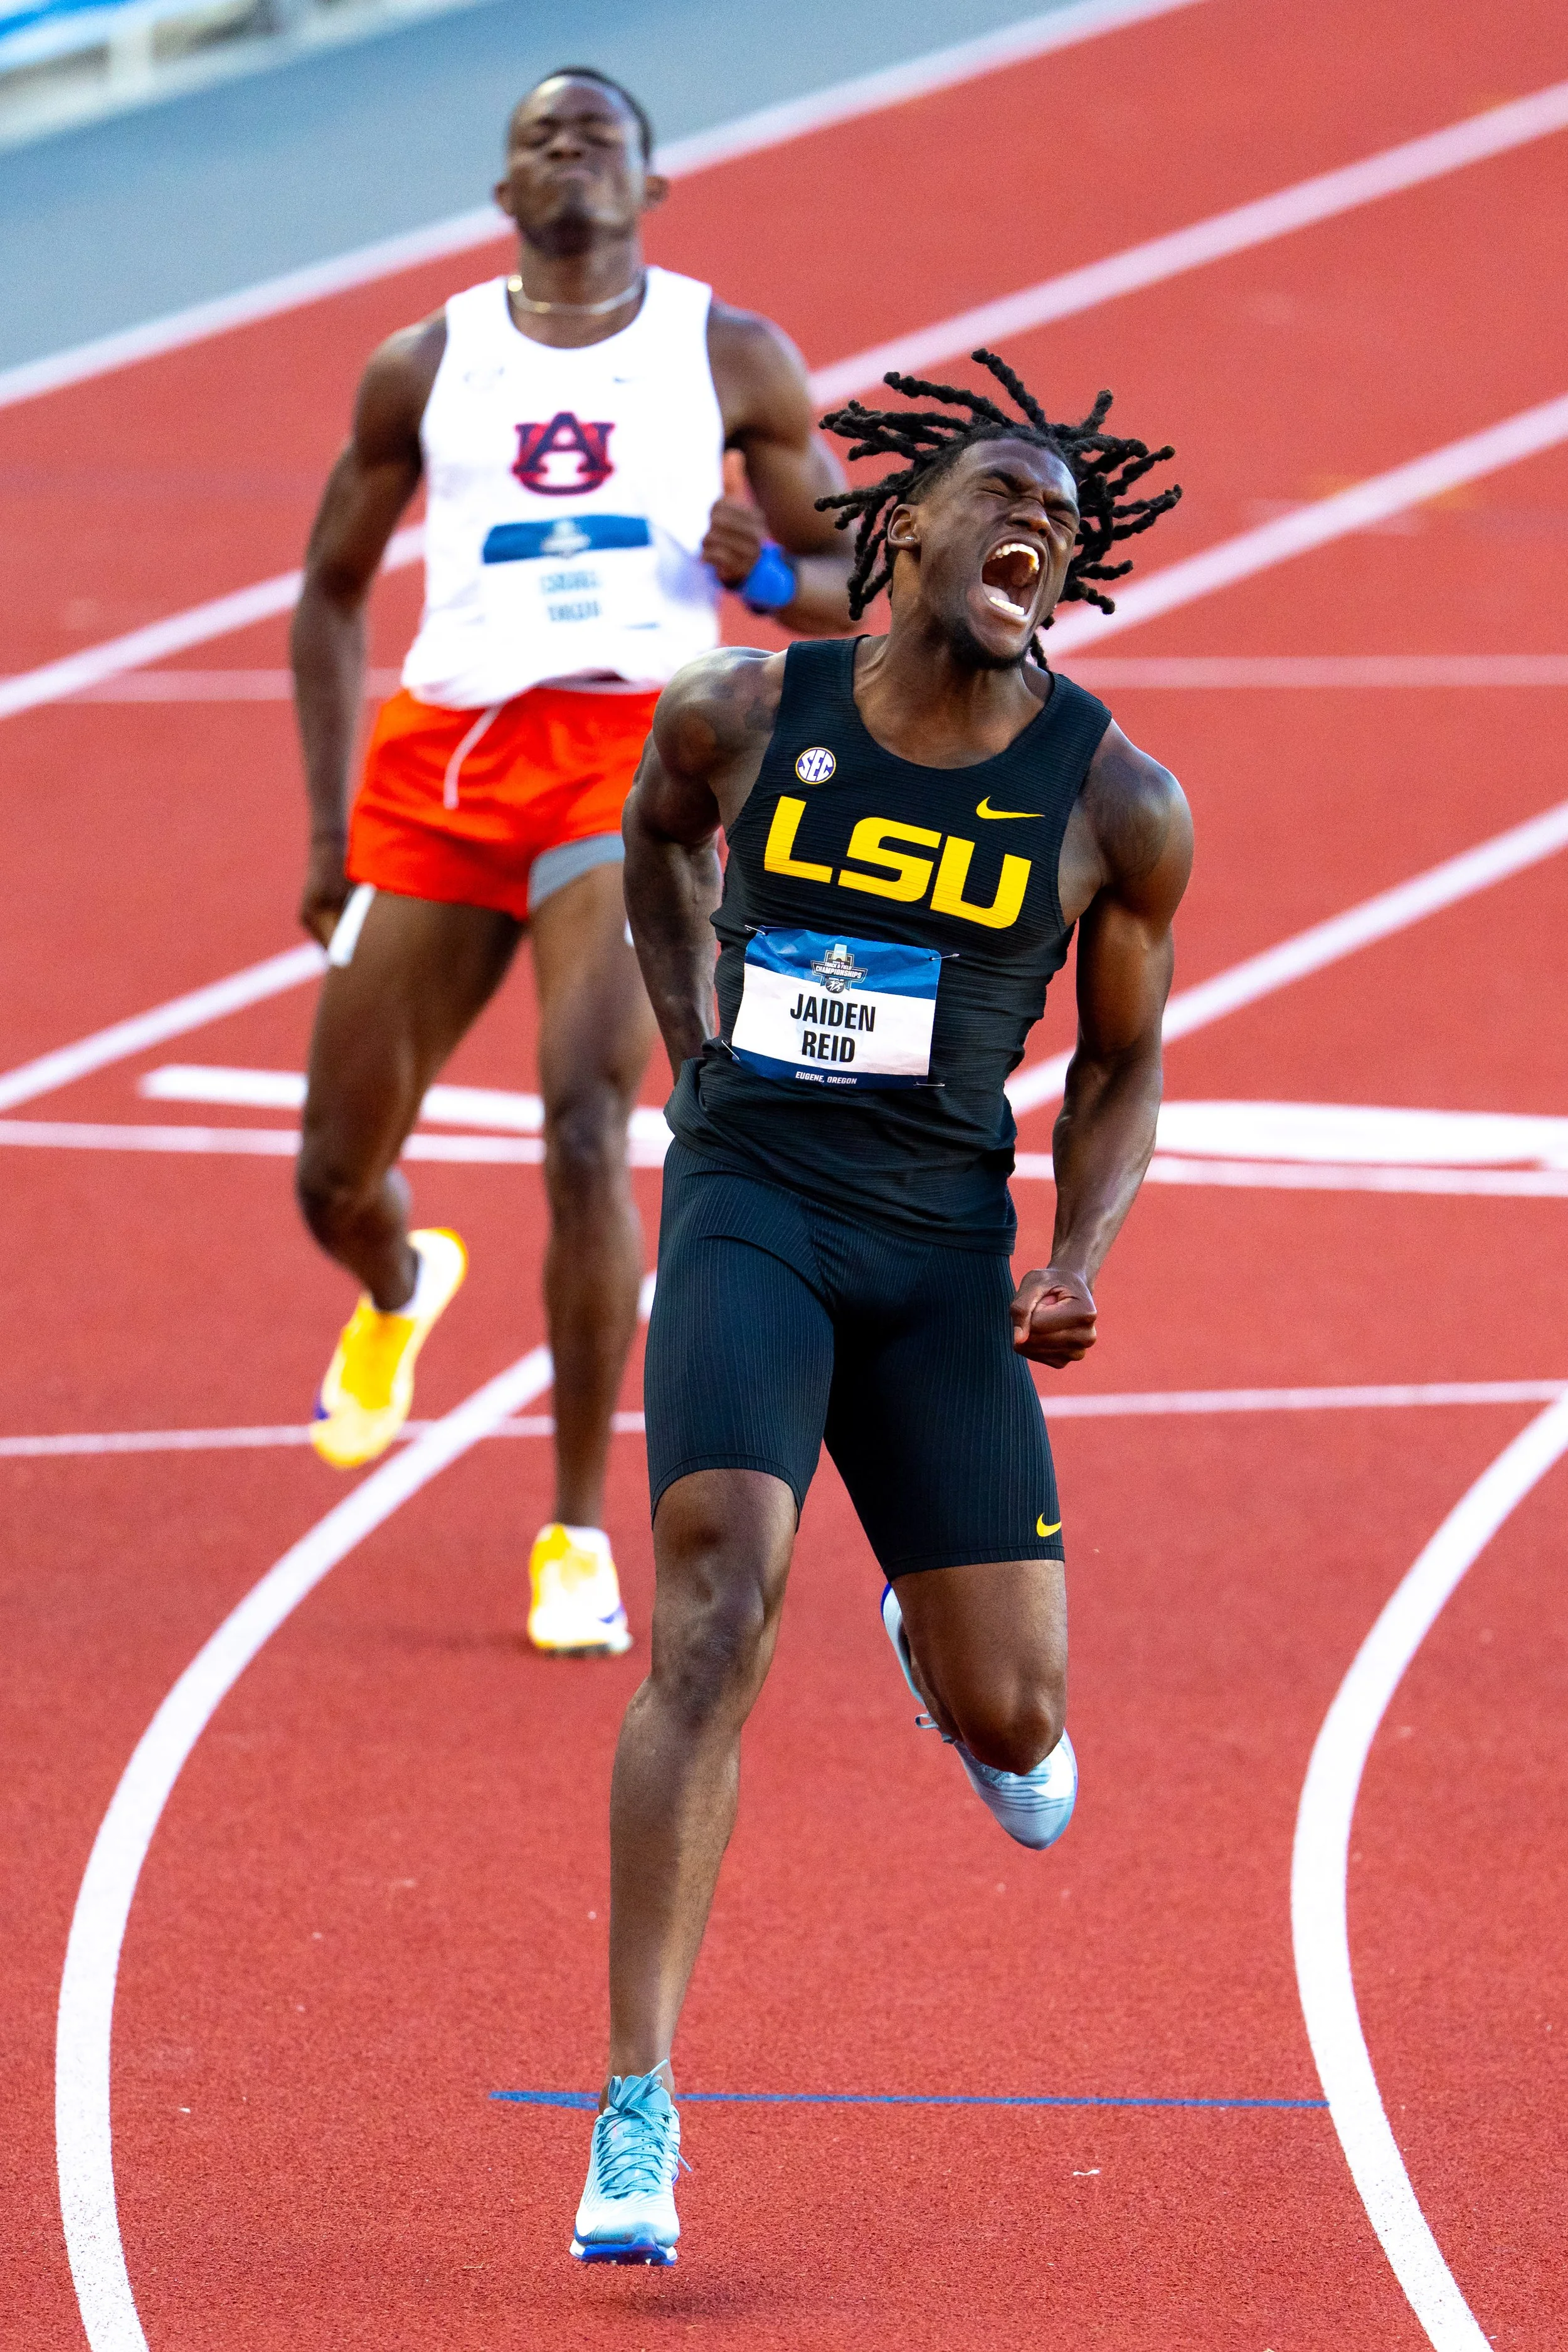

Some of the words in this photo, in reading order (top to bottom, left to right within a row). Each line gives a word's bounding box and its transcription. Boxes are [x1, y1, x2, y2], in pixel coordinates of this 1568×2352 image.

[798, 749, 834, 782] SEC
[765, 796, 1031, 928] LSU
[815, 965, 862, 978] CHAMPIONSHIPS
[790, 993, 876, 1032] JAIDEN
[802, 1030, 855, 1062] REID
[795, 1071, 825, 1083] EUGENE,
[827, 1076, 857, 1084] OREGON
